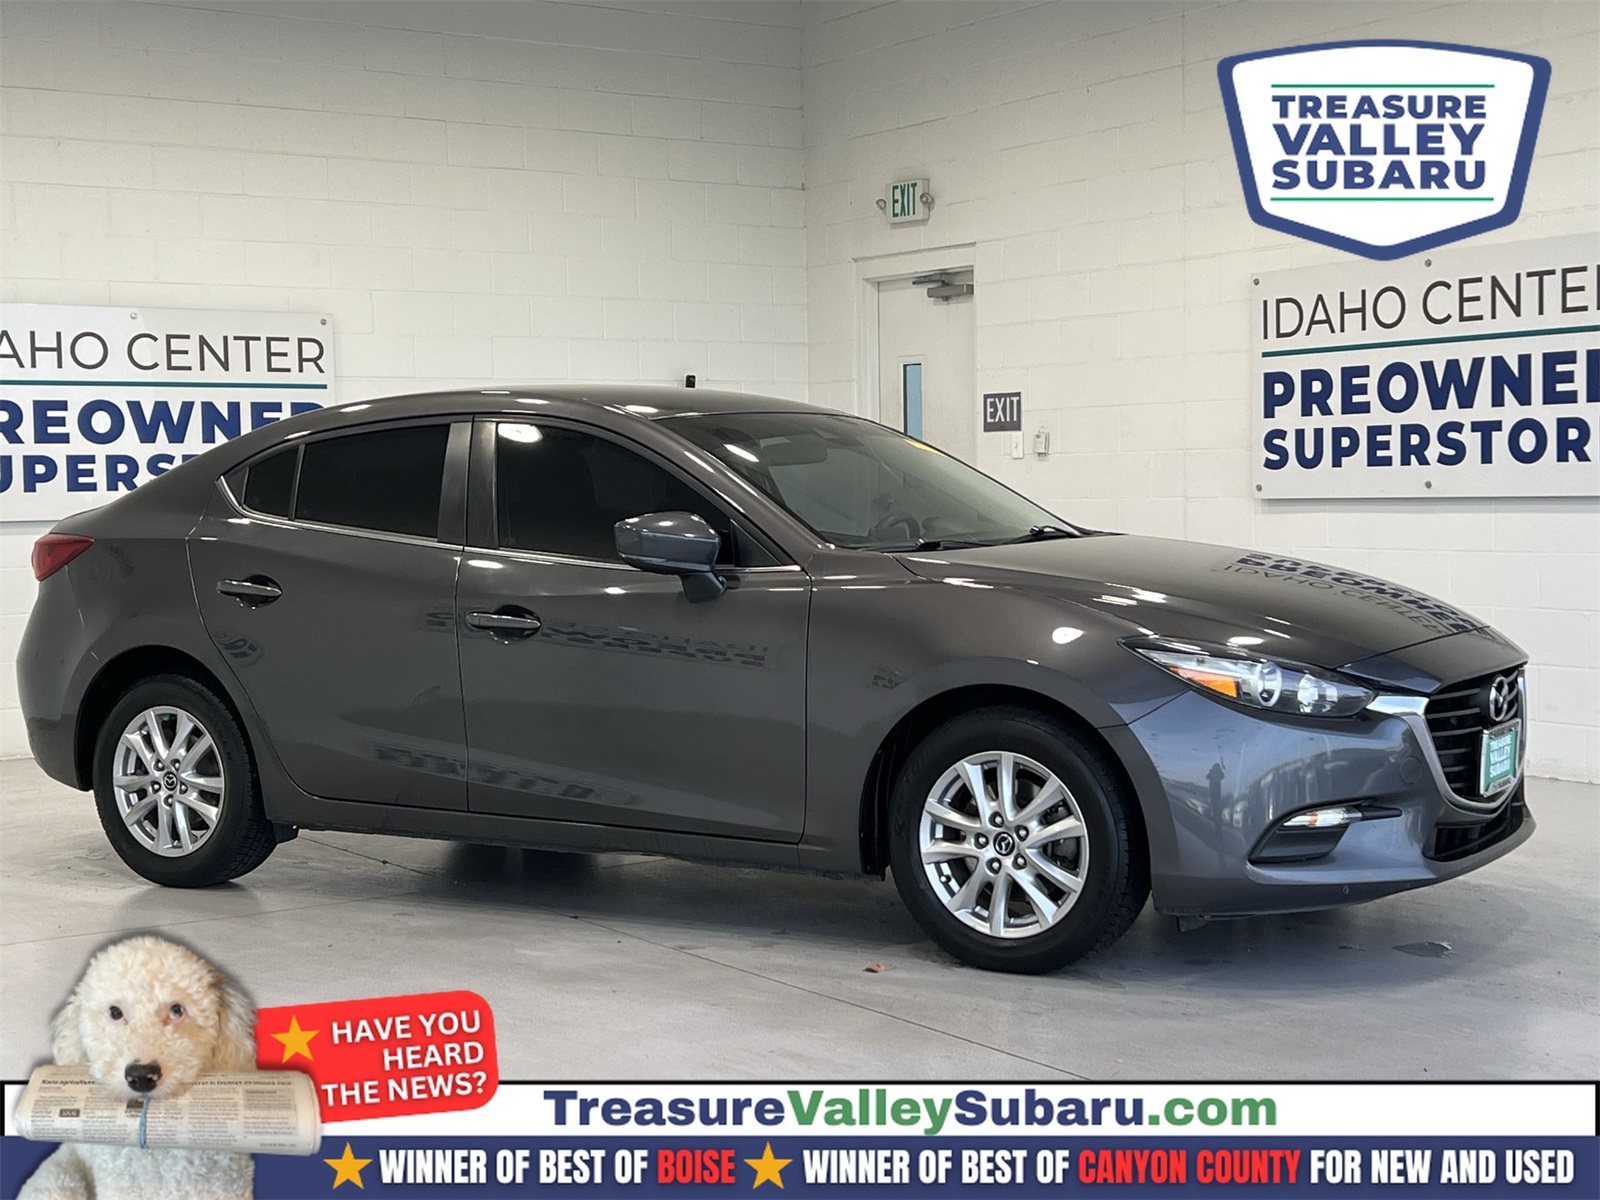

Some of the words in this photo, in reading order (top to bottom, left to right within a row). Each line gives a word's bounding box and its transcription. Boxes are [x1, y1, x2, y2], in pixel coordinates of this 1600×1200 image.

[891, 181, 918, 218] EXIT
[1262, 285, 1407, 341] IDAHO
[1421, 264, 1600, 326] CENTE
[127, 332, 326, 374] CENTER
[0, 398, 326, 445] REOWNE
[986, 396, 1020, 424] EXIT
[1262, 416, 1600, 471] SUPERSTOR
[0, 452, 201, 494] PERS
